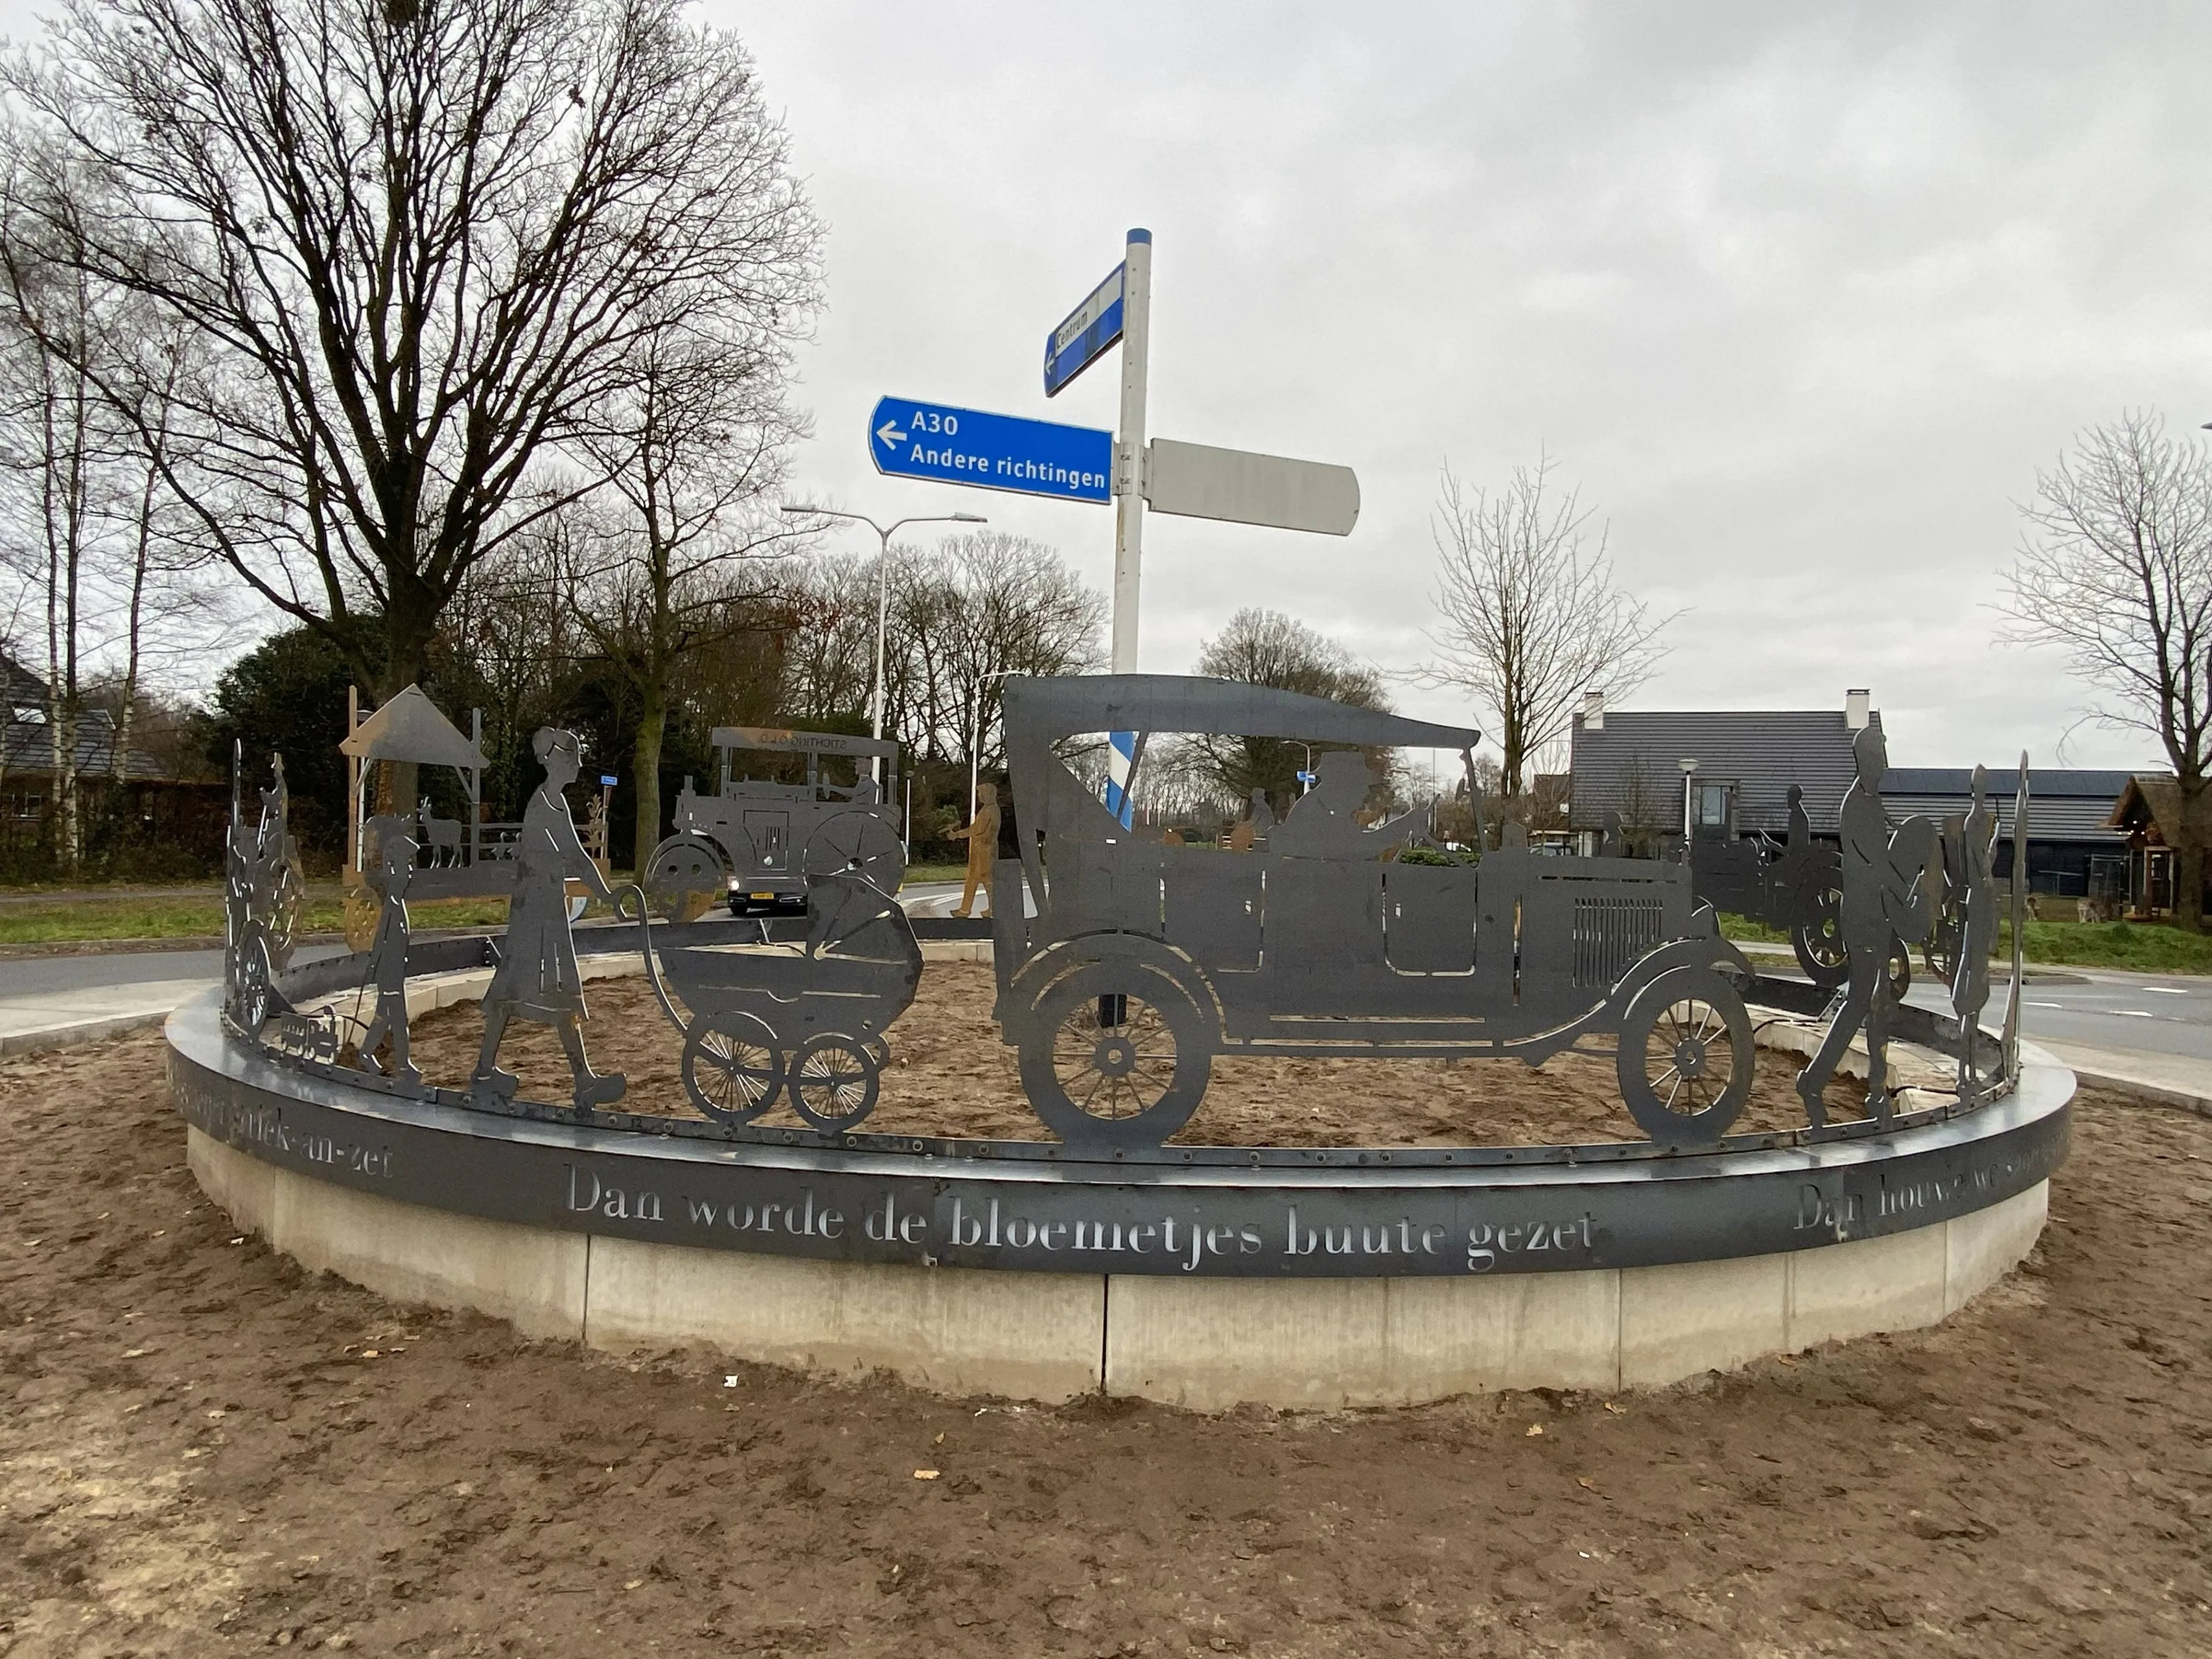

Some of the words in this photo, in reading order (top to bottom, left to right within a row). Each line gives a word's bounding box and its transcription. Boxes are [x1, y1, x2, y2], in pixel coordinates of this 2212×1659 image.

[1056, 311, 1088, 348] Centrum
[911, 412, 959, 436] A30
[911, 443, 989, 473] Andere
[996, 456, 1106, 490] richtingen
[564, 1163, 664, 1221] Dan
[682, 1186, 844, 1239] worde
[865, 1191, 927, 1244] de
[947, 1195, 1263, 1271] bloemetjes
[1283, 1203, 1447, 1257] buute
[1467, 1210, 1598, 1273] gezet
[1793, 1184, 1864, 1230] Dan
